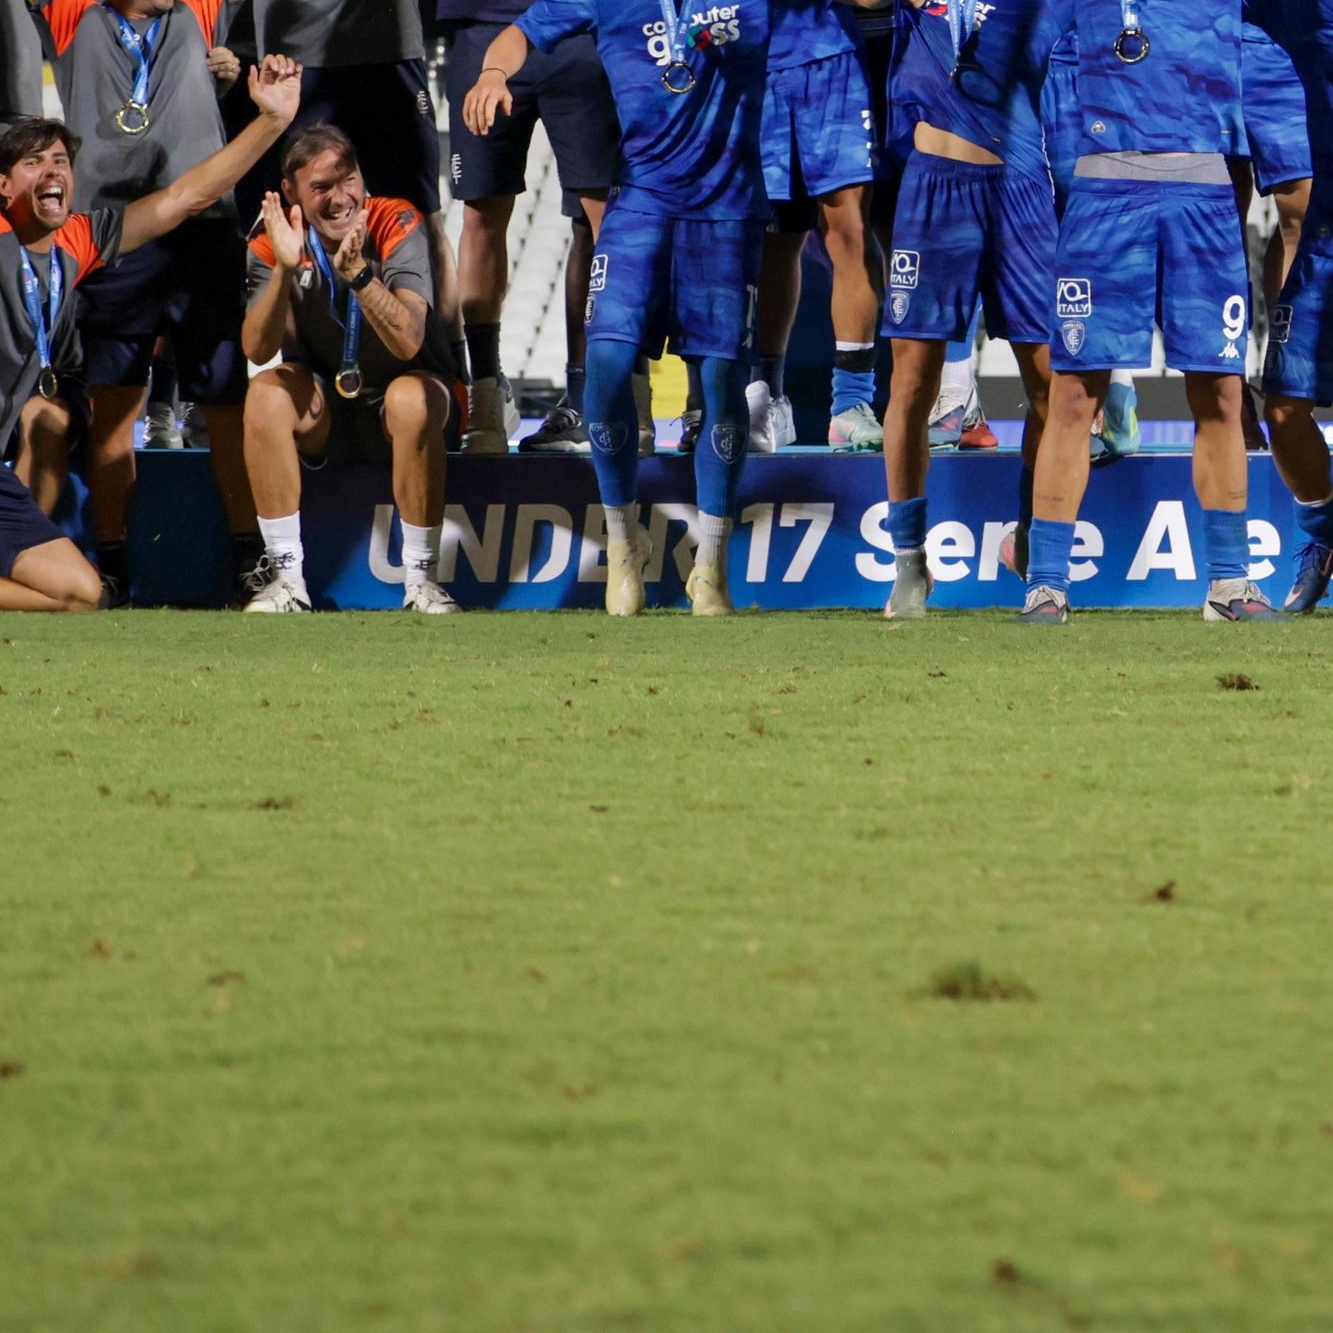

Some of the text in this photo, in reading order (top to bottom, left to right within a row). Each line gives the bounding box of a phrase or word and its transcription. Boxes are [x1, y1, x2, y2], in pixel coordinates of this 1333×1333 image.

[642, 5, 740, 37] couter
[647, 18, 740, 66] goss
[1059, 303, 1089, 313] ITALY
[1221, 294, 1246, 340] 9
[742, 501, 836, 584] 17
[854, 499, 1104, 583] Sere
[1125, 499, 1197, 581] A
